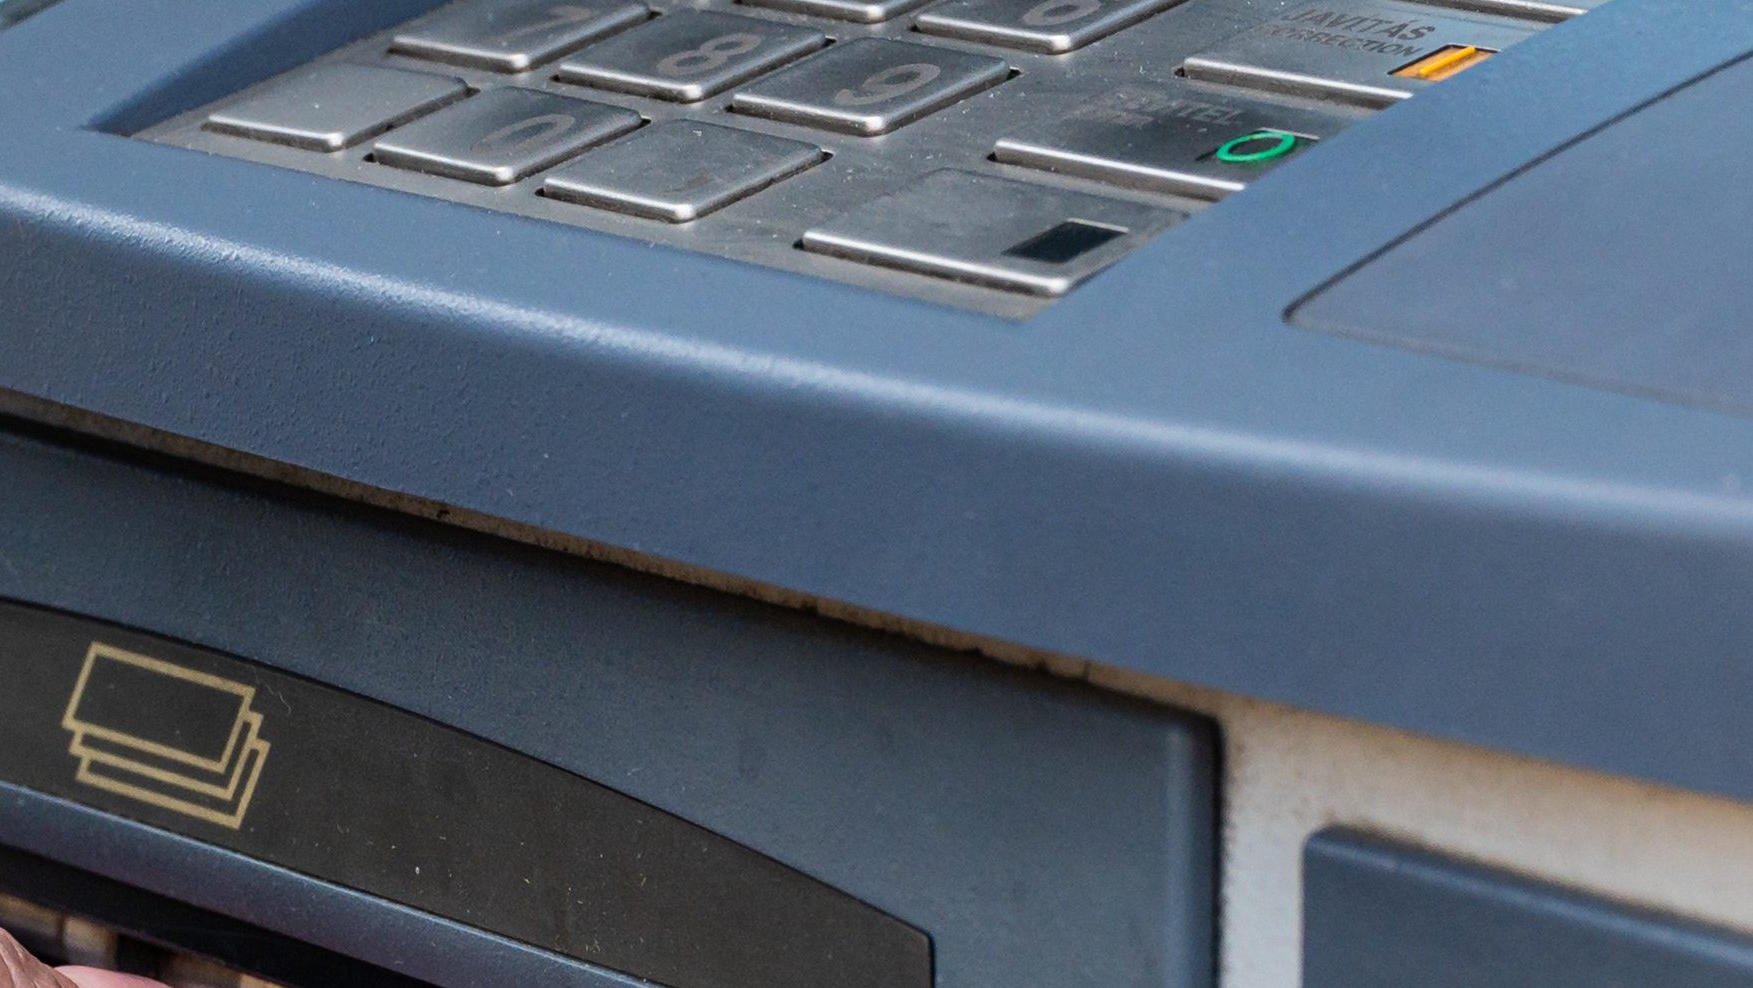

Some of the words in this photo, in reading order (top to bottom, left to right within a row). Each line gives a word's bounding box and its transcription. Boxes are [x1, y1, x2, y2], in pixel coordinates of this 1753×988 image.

[497, 5, 592, 42] 7
[1252, 23, 1423, 57] ORRECTION
[654, 32, 761, 78] 8
[833, 63, 942, 103] 9
[469, 113, 576, 155] 0
